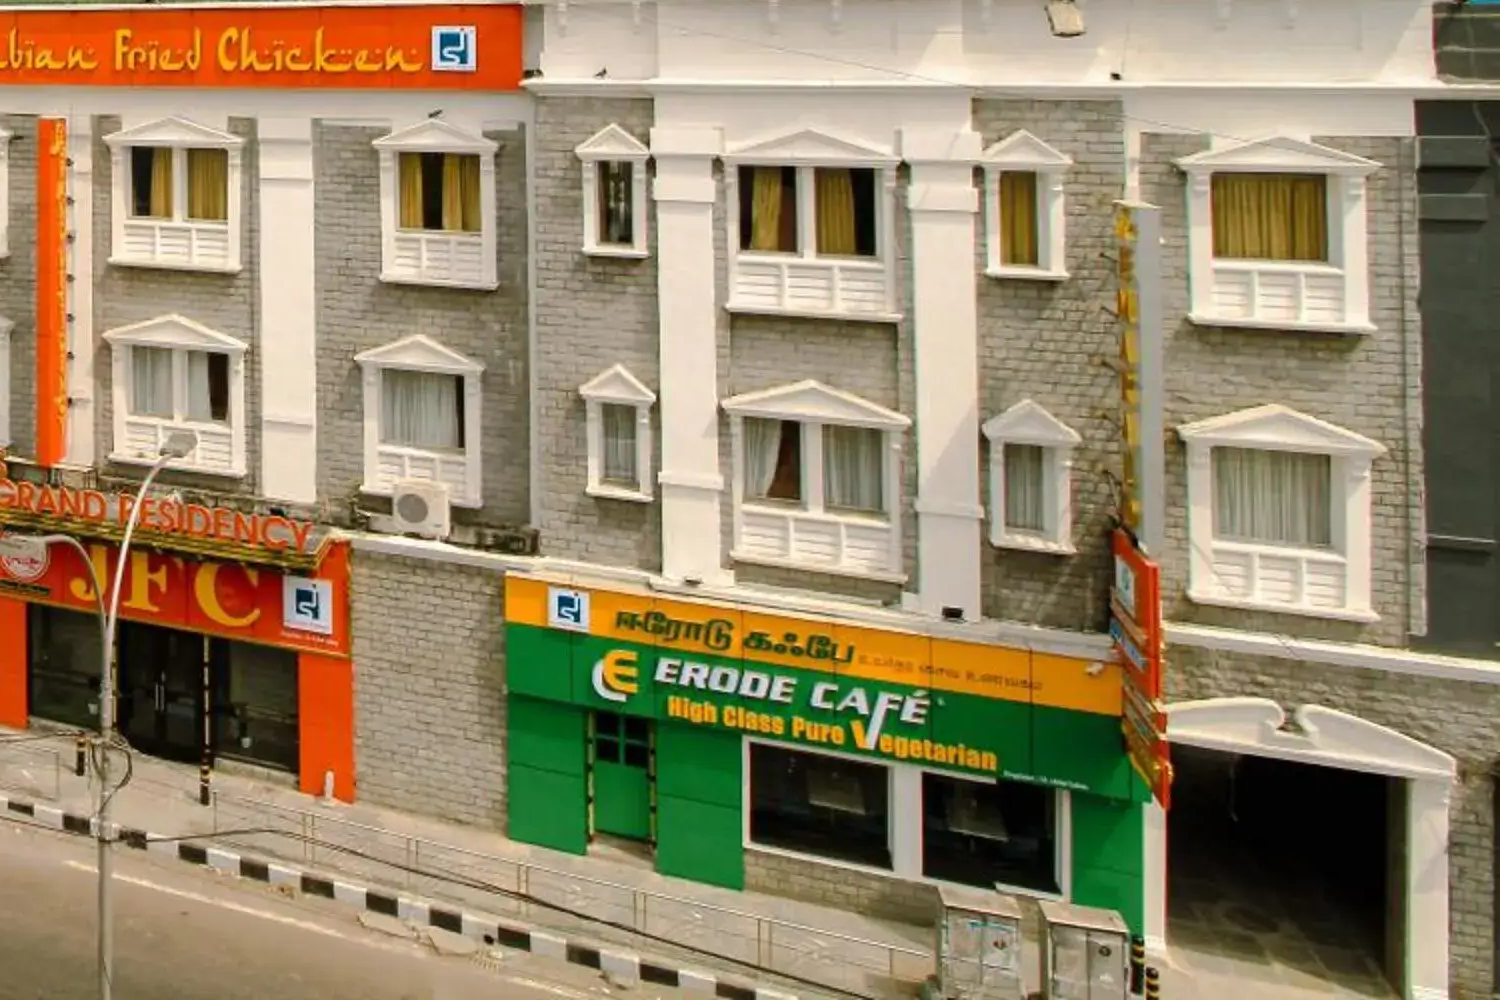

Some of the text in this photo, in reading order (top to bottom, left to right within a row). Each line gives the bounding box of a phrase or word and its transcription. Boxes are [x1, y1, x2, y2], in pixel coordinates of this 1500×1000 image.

[114, 26, 202, 71] Fried
[217, 25, 423, 72] Chicken
[118, 493, 313, 554] RESIDENCY
[653, 656, 932, 750] ERODE CAFÉ
[667, 695, 998, 772] High Class Pure Vegetarian
